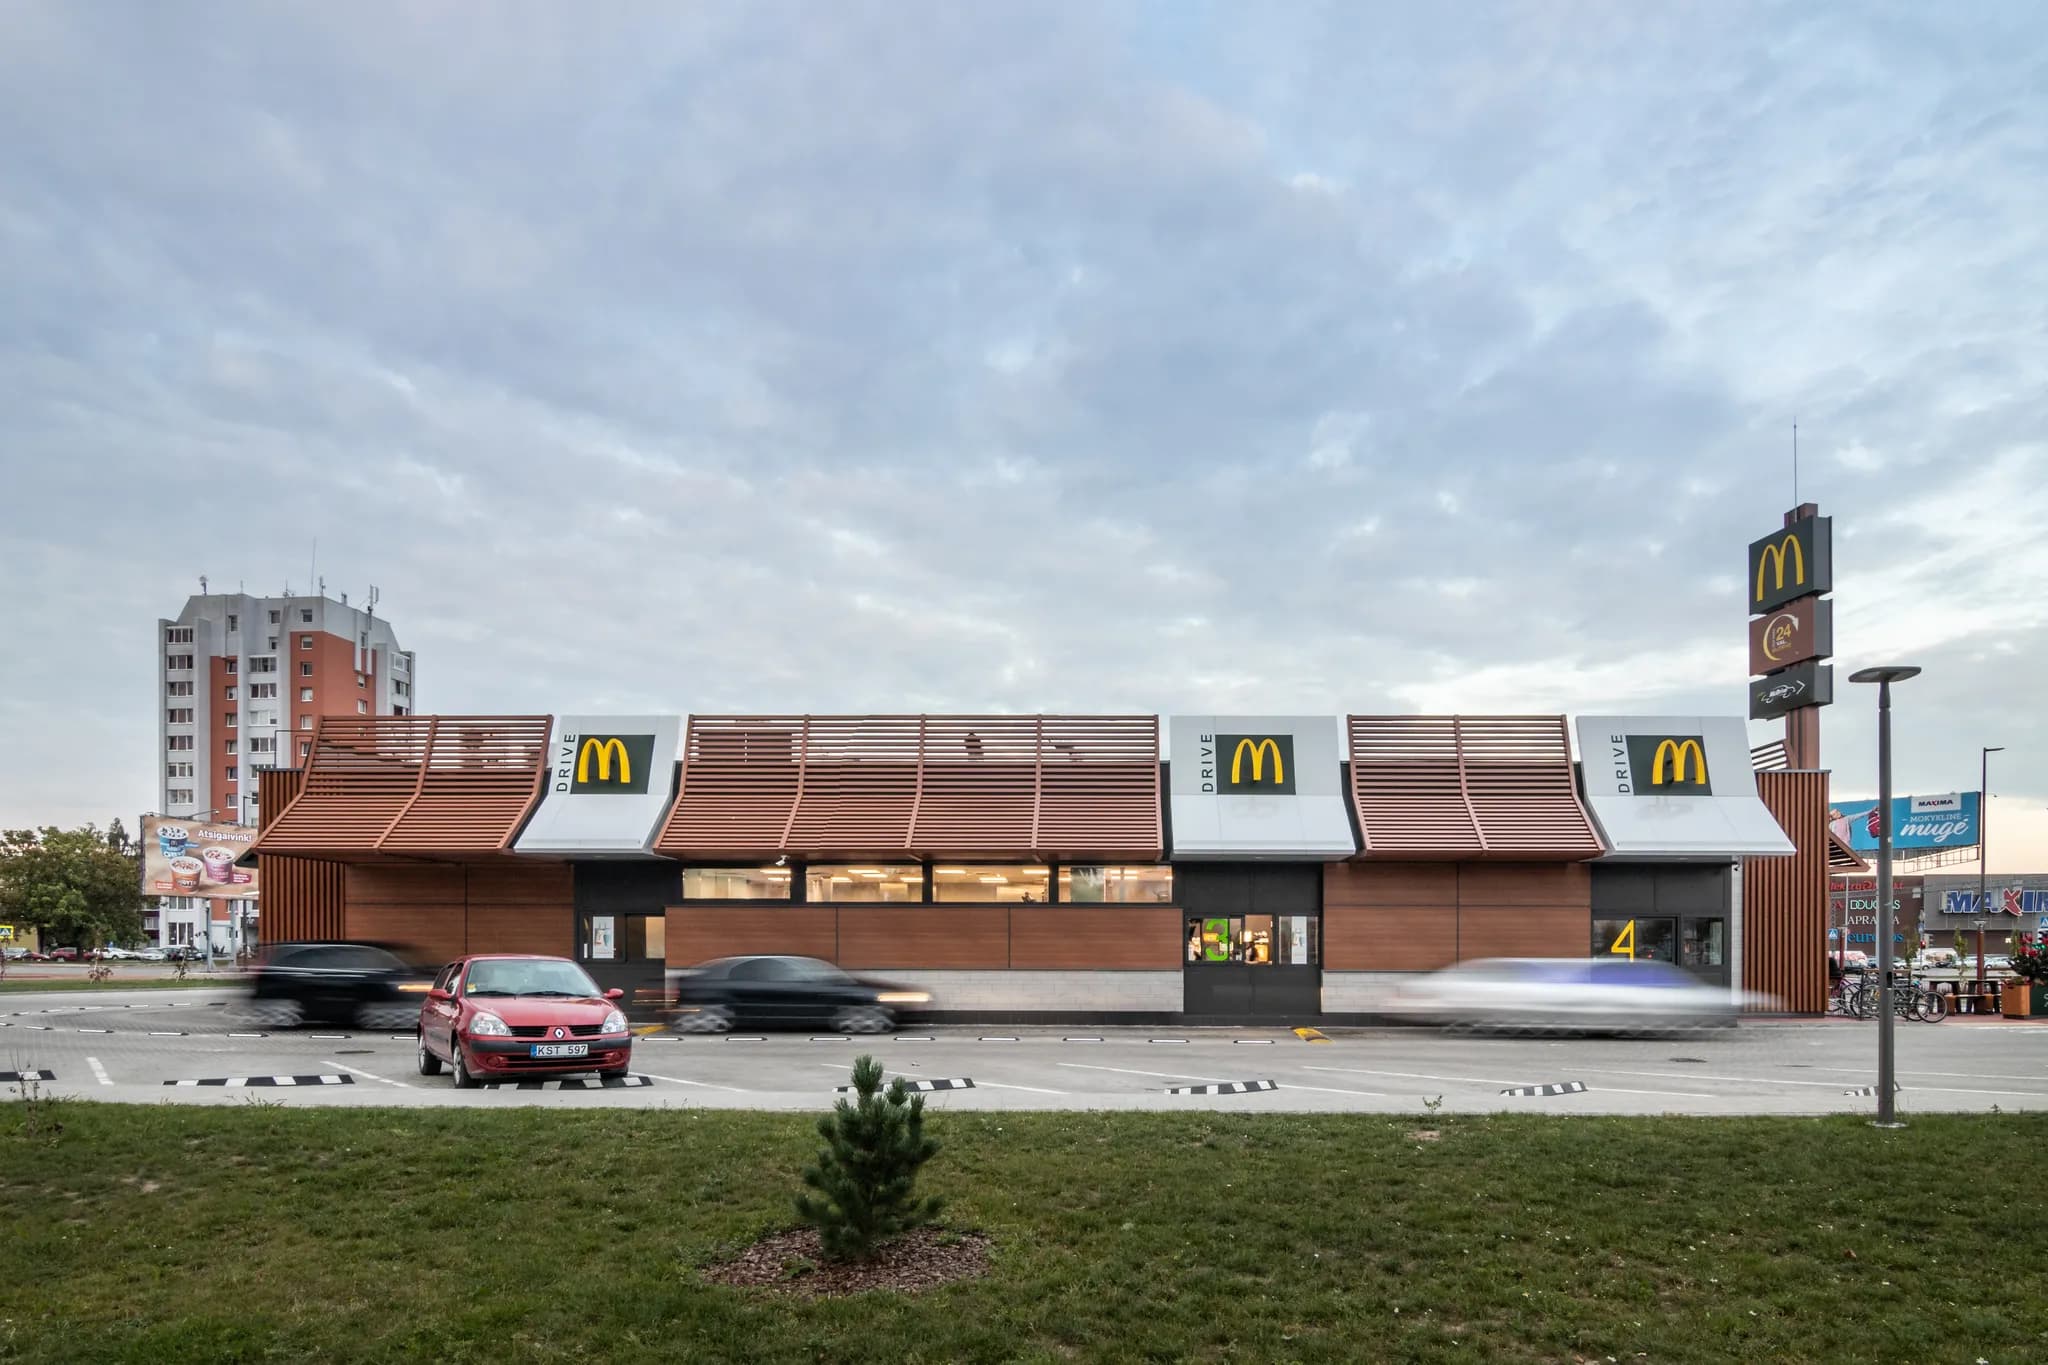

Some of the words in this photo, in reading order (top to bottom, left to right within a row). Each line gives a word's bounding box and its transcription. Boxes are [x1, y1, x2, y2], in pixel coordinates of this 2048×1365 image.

[1776, 624, 1791, 641] 24
[556, 734, 576, 792] DRIVE
[1201, 734, 1213, 792] DRIVE
[1611, 735, 1630, 793] DRIVE
[1918, 799, 1954, 807] MAXIMA
[198, 830, 252, 842] Atsigaivink!
[1850, 900, 1901, 910] DOUS
[1847, 915, 1900, 925] APRAA
[1205, 919, 1228, 961] 3
[1611, 919, 1634, 962] 4
[538, 1046, 560, 1055] KST
[567, 1045, 586, 1054] 597
